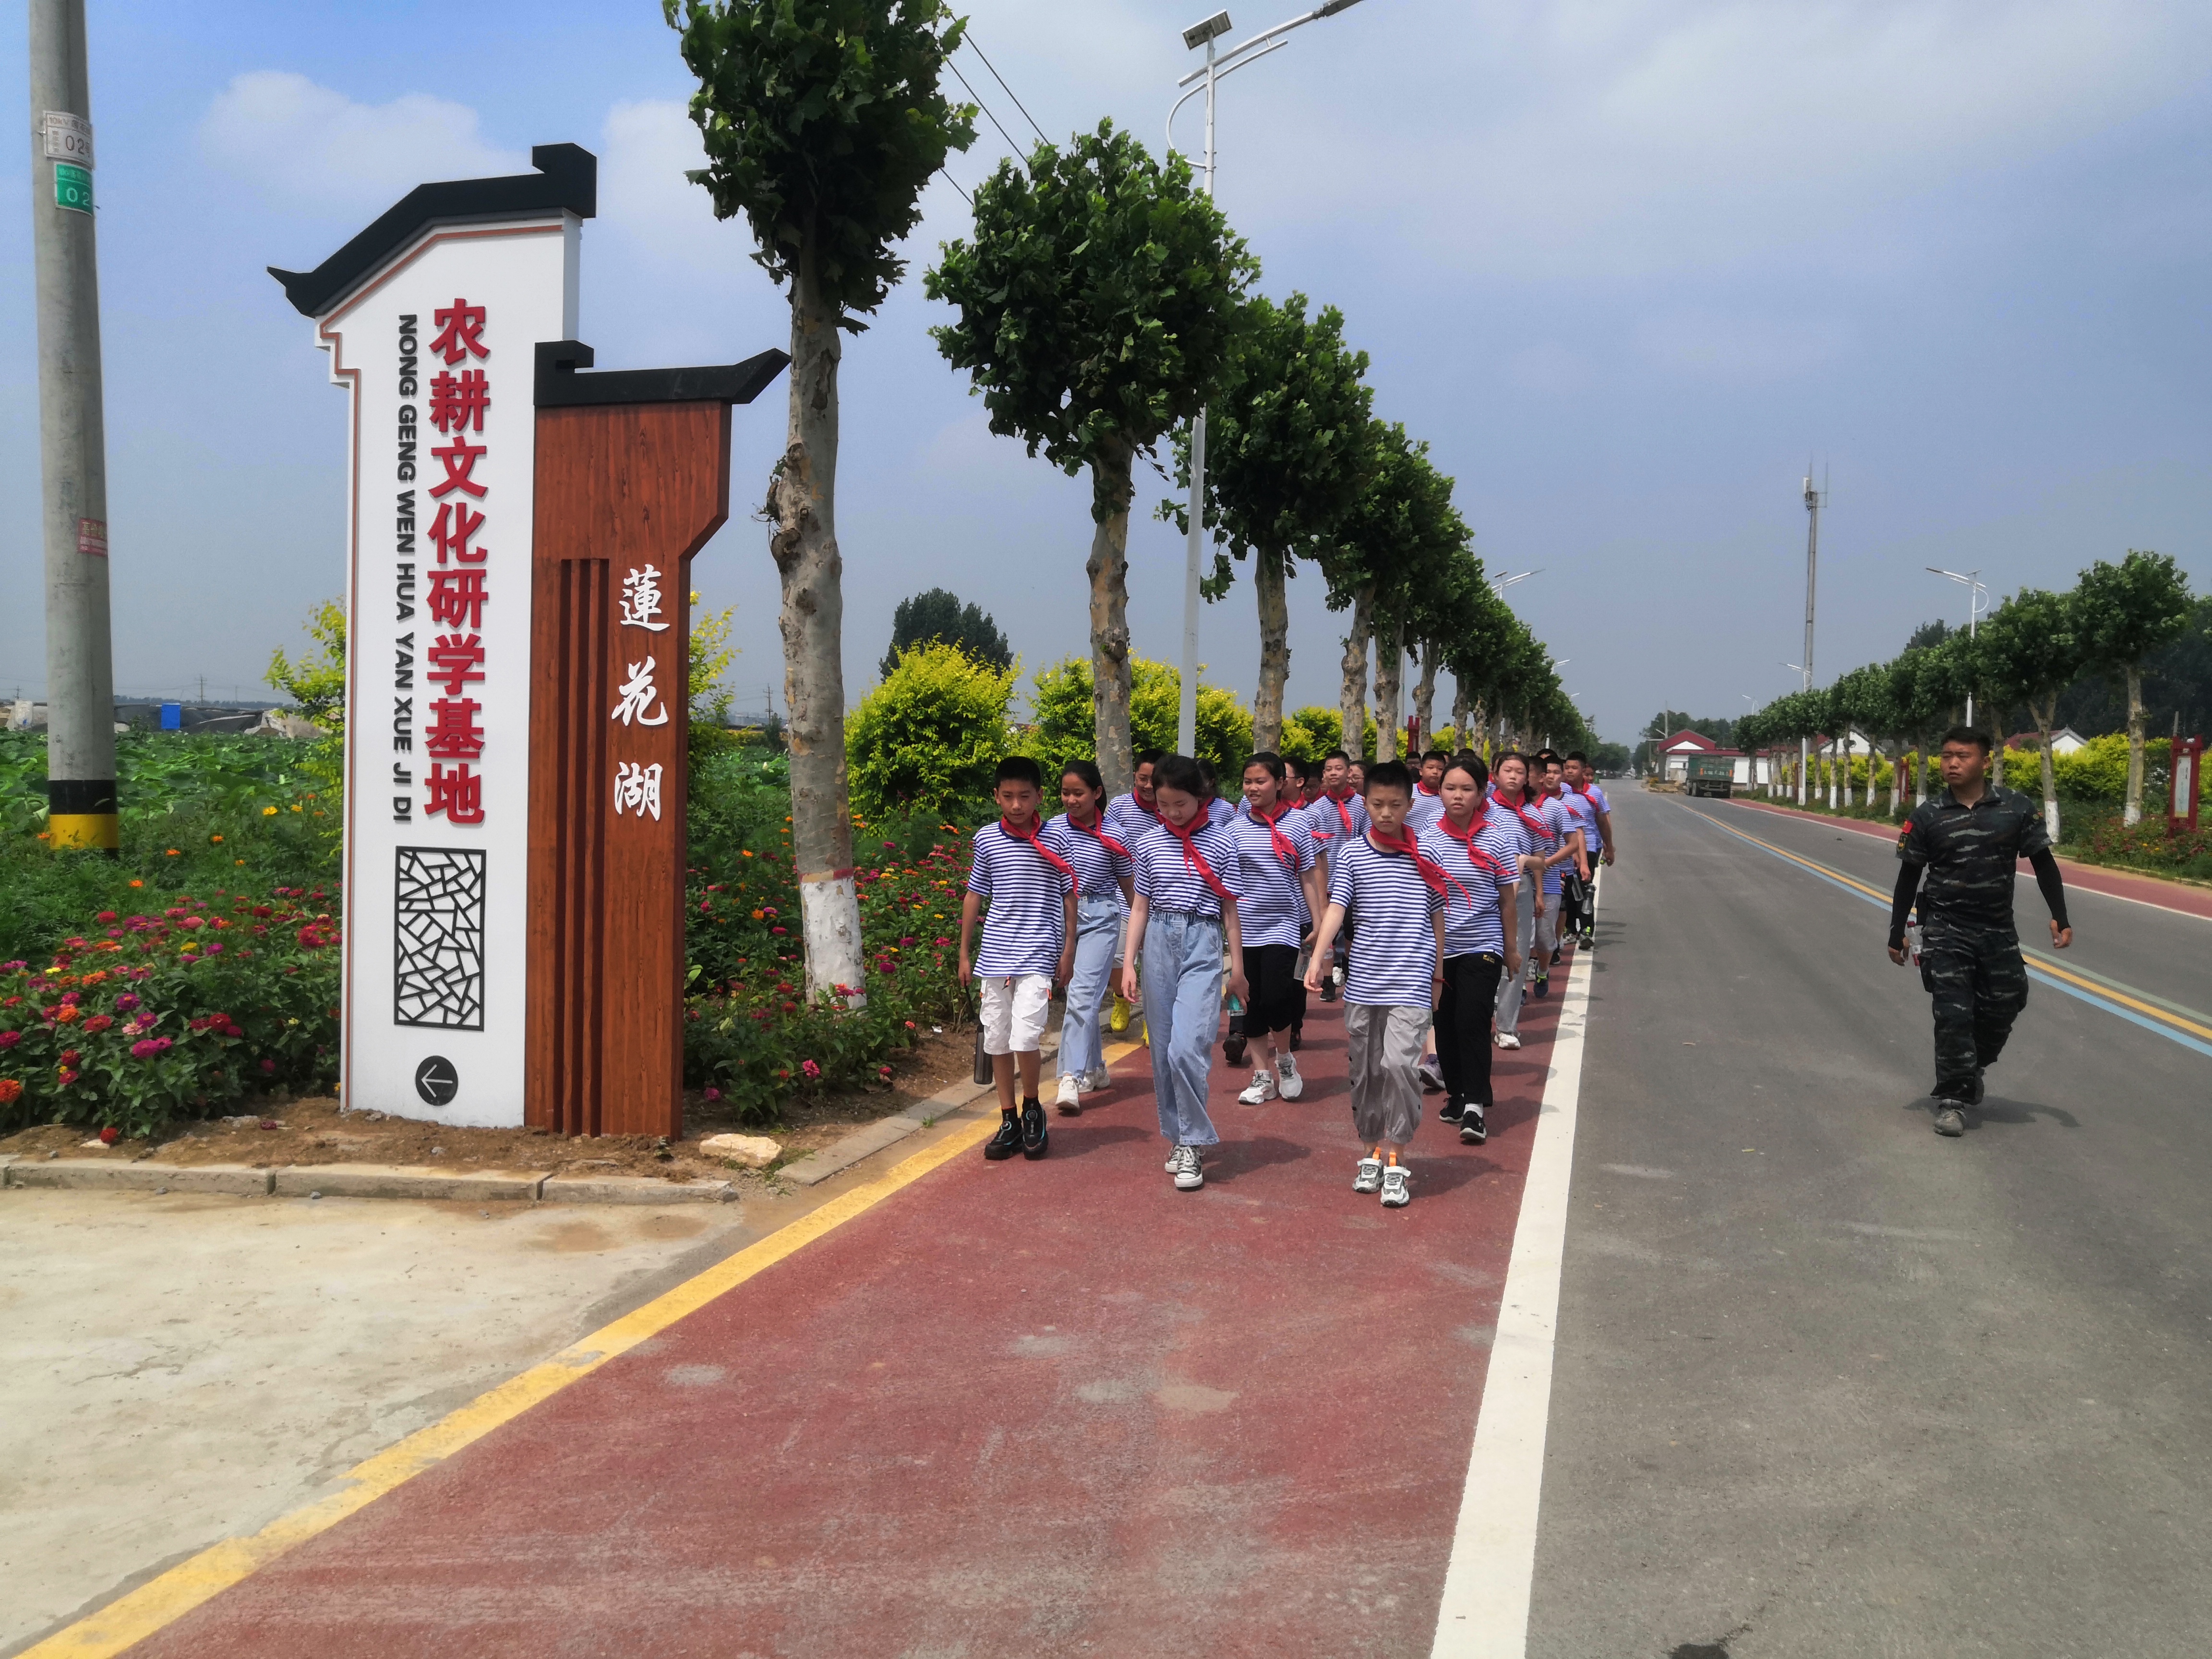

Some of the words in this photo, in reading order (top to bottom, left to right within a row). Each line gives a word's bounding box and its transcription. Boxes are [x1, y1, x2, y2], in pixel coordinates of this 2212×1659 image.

[399, 314, 418, 396] NONG
[398, 405, 417, 481] GENG
[397, 490, 415, 553] WEN
[424, 298, 490, 824] 农耕文化研学基地
[396, 563, 415, 621] HUA
[395, 632, 414, 688] YAN
[393, 697, 413, 751] XUE
[393, 762, 411, 784] JI
[393, 797, 411, 821] DI
